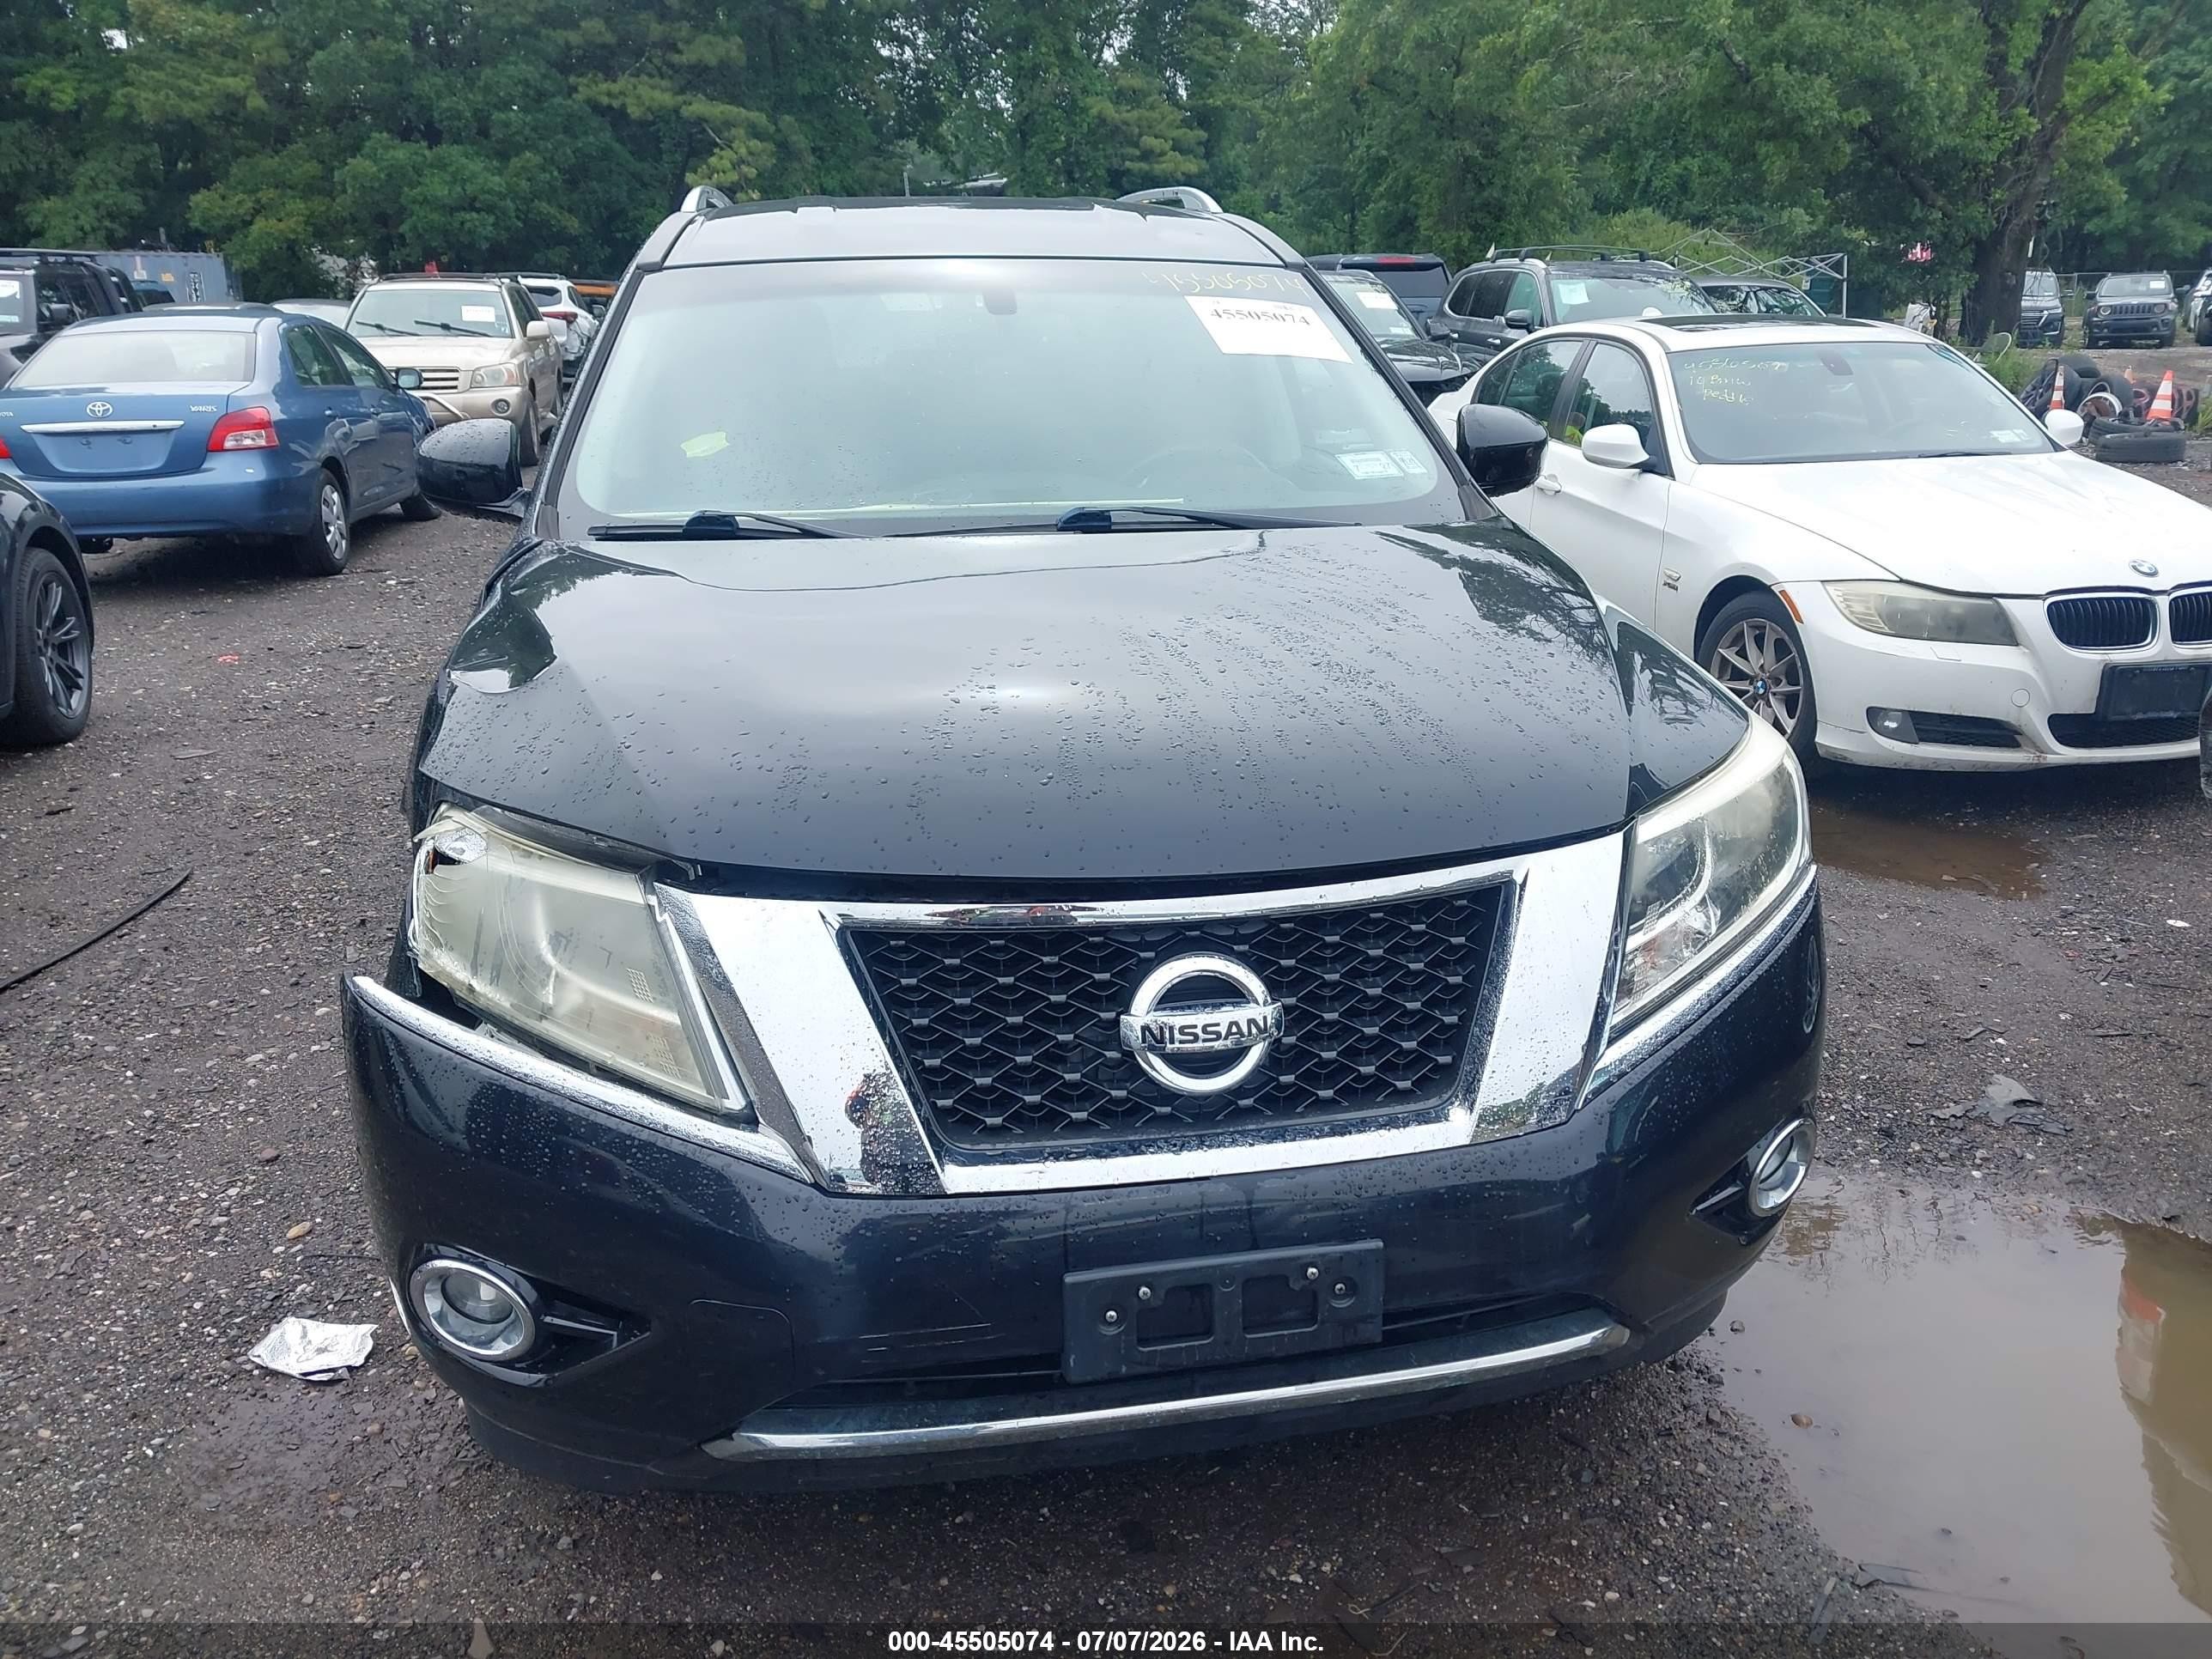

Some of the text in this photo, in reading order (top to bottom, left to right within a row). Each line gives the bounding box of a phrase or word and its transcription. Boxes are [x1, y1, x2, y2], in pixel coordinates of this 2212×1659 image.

[1211, 308, 1311, 326] 45505074
[189, 404, 218, 413] YARIS
[1140, 1015, 1269, 1045] NISSAN
